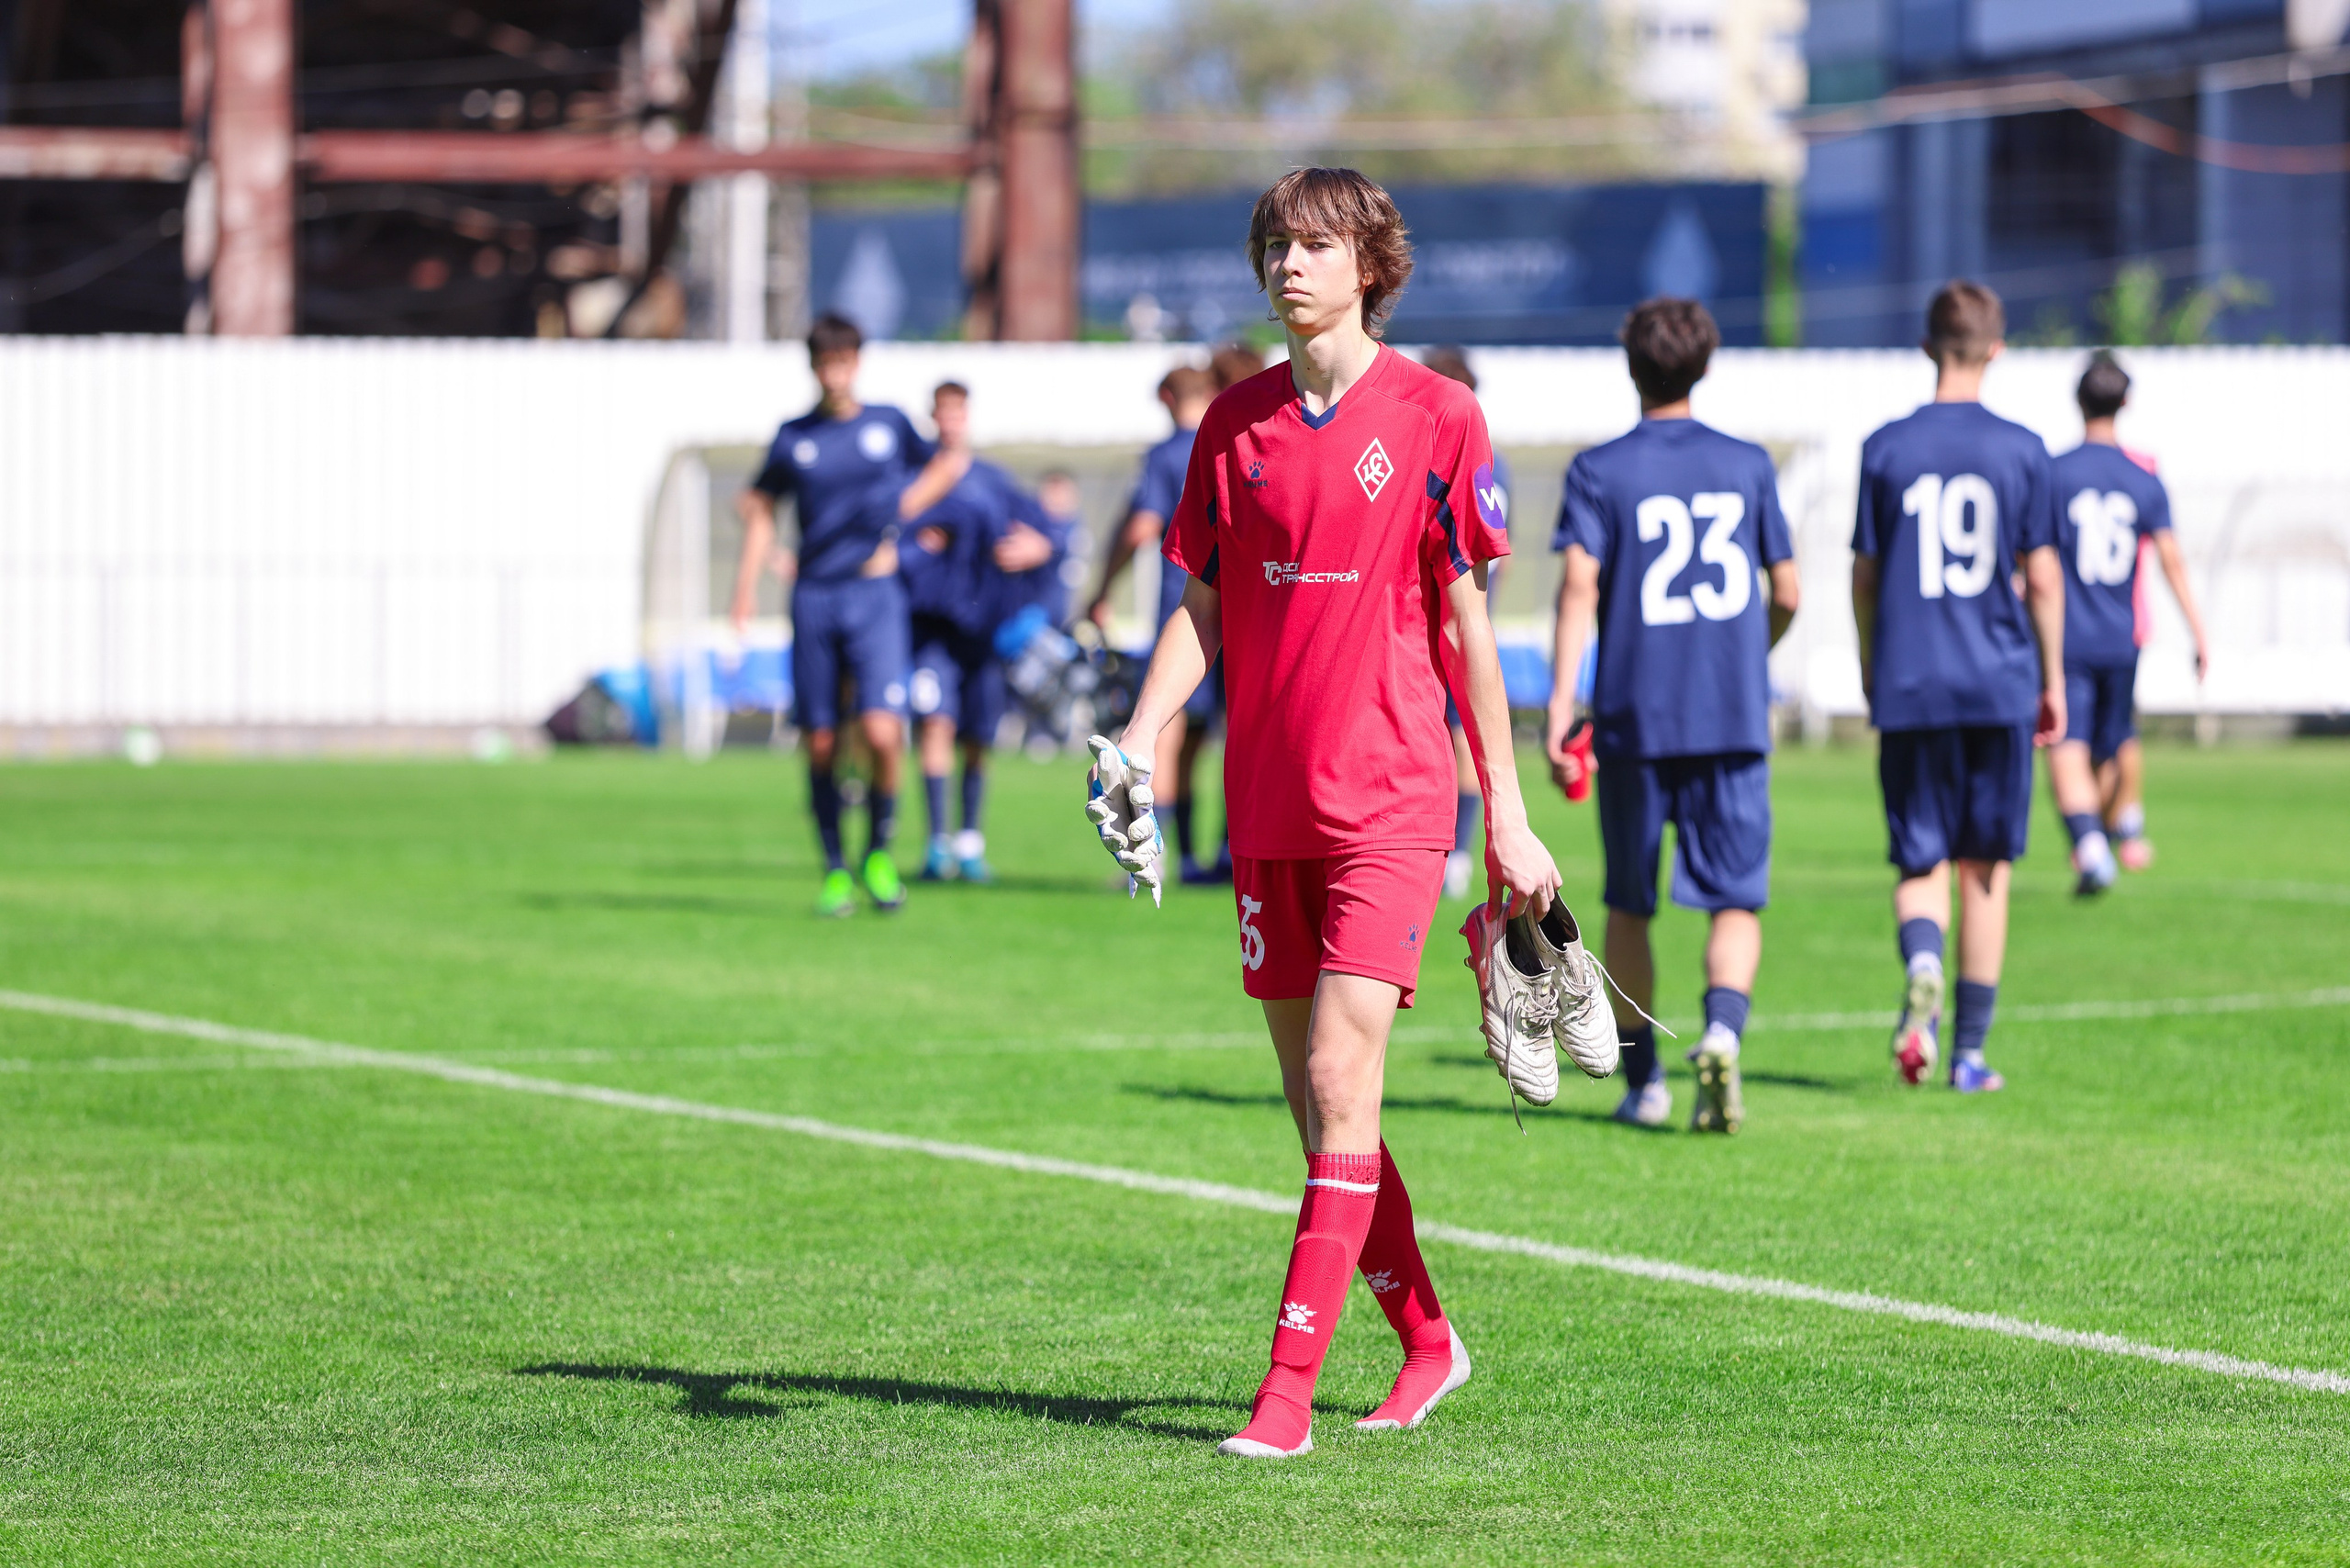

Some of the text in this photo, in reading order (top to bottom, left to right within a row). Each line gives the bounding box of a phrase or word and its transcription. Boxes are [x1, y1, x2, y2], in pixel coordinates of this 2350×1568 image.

[1281, 570, 1359, 584] ТРАНССТРОЙ
[1637, 492, 1751, 625] 23
[1903, 474, 1998, 599] 19
[2067, 488, 2137, 586] 16
[1279, 1318, 1315, 1334] KELME
